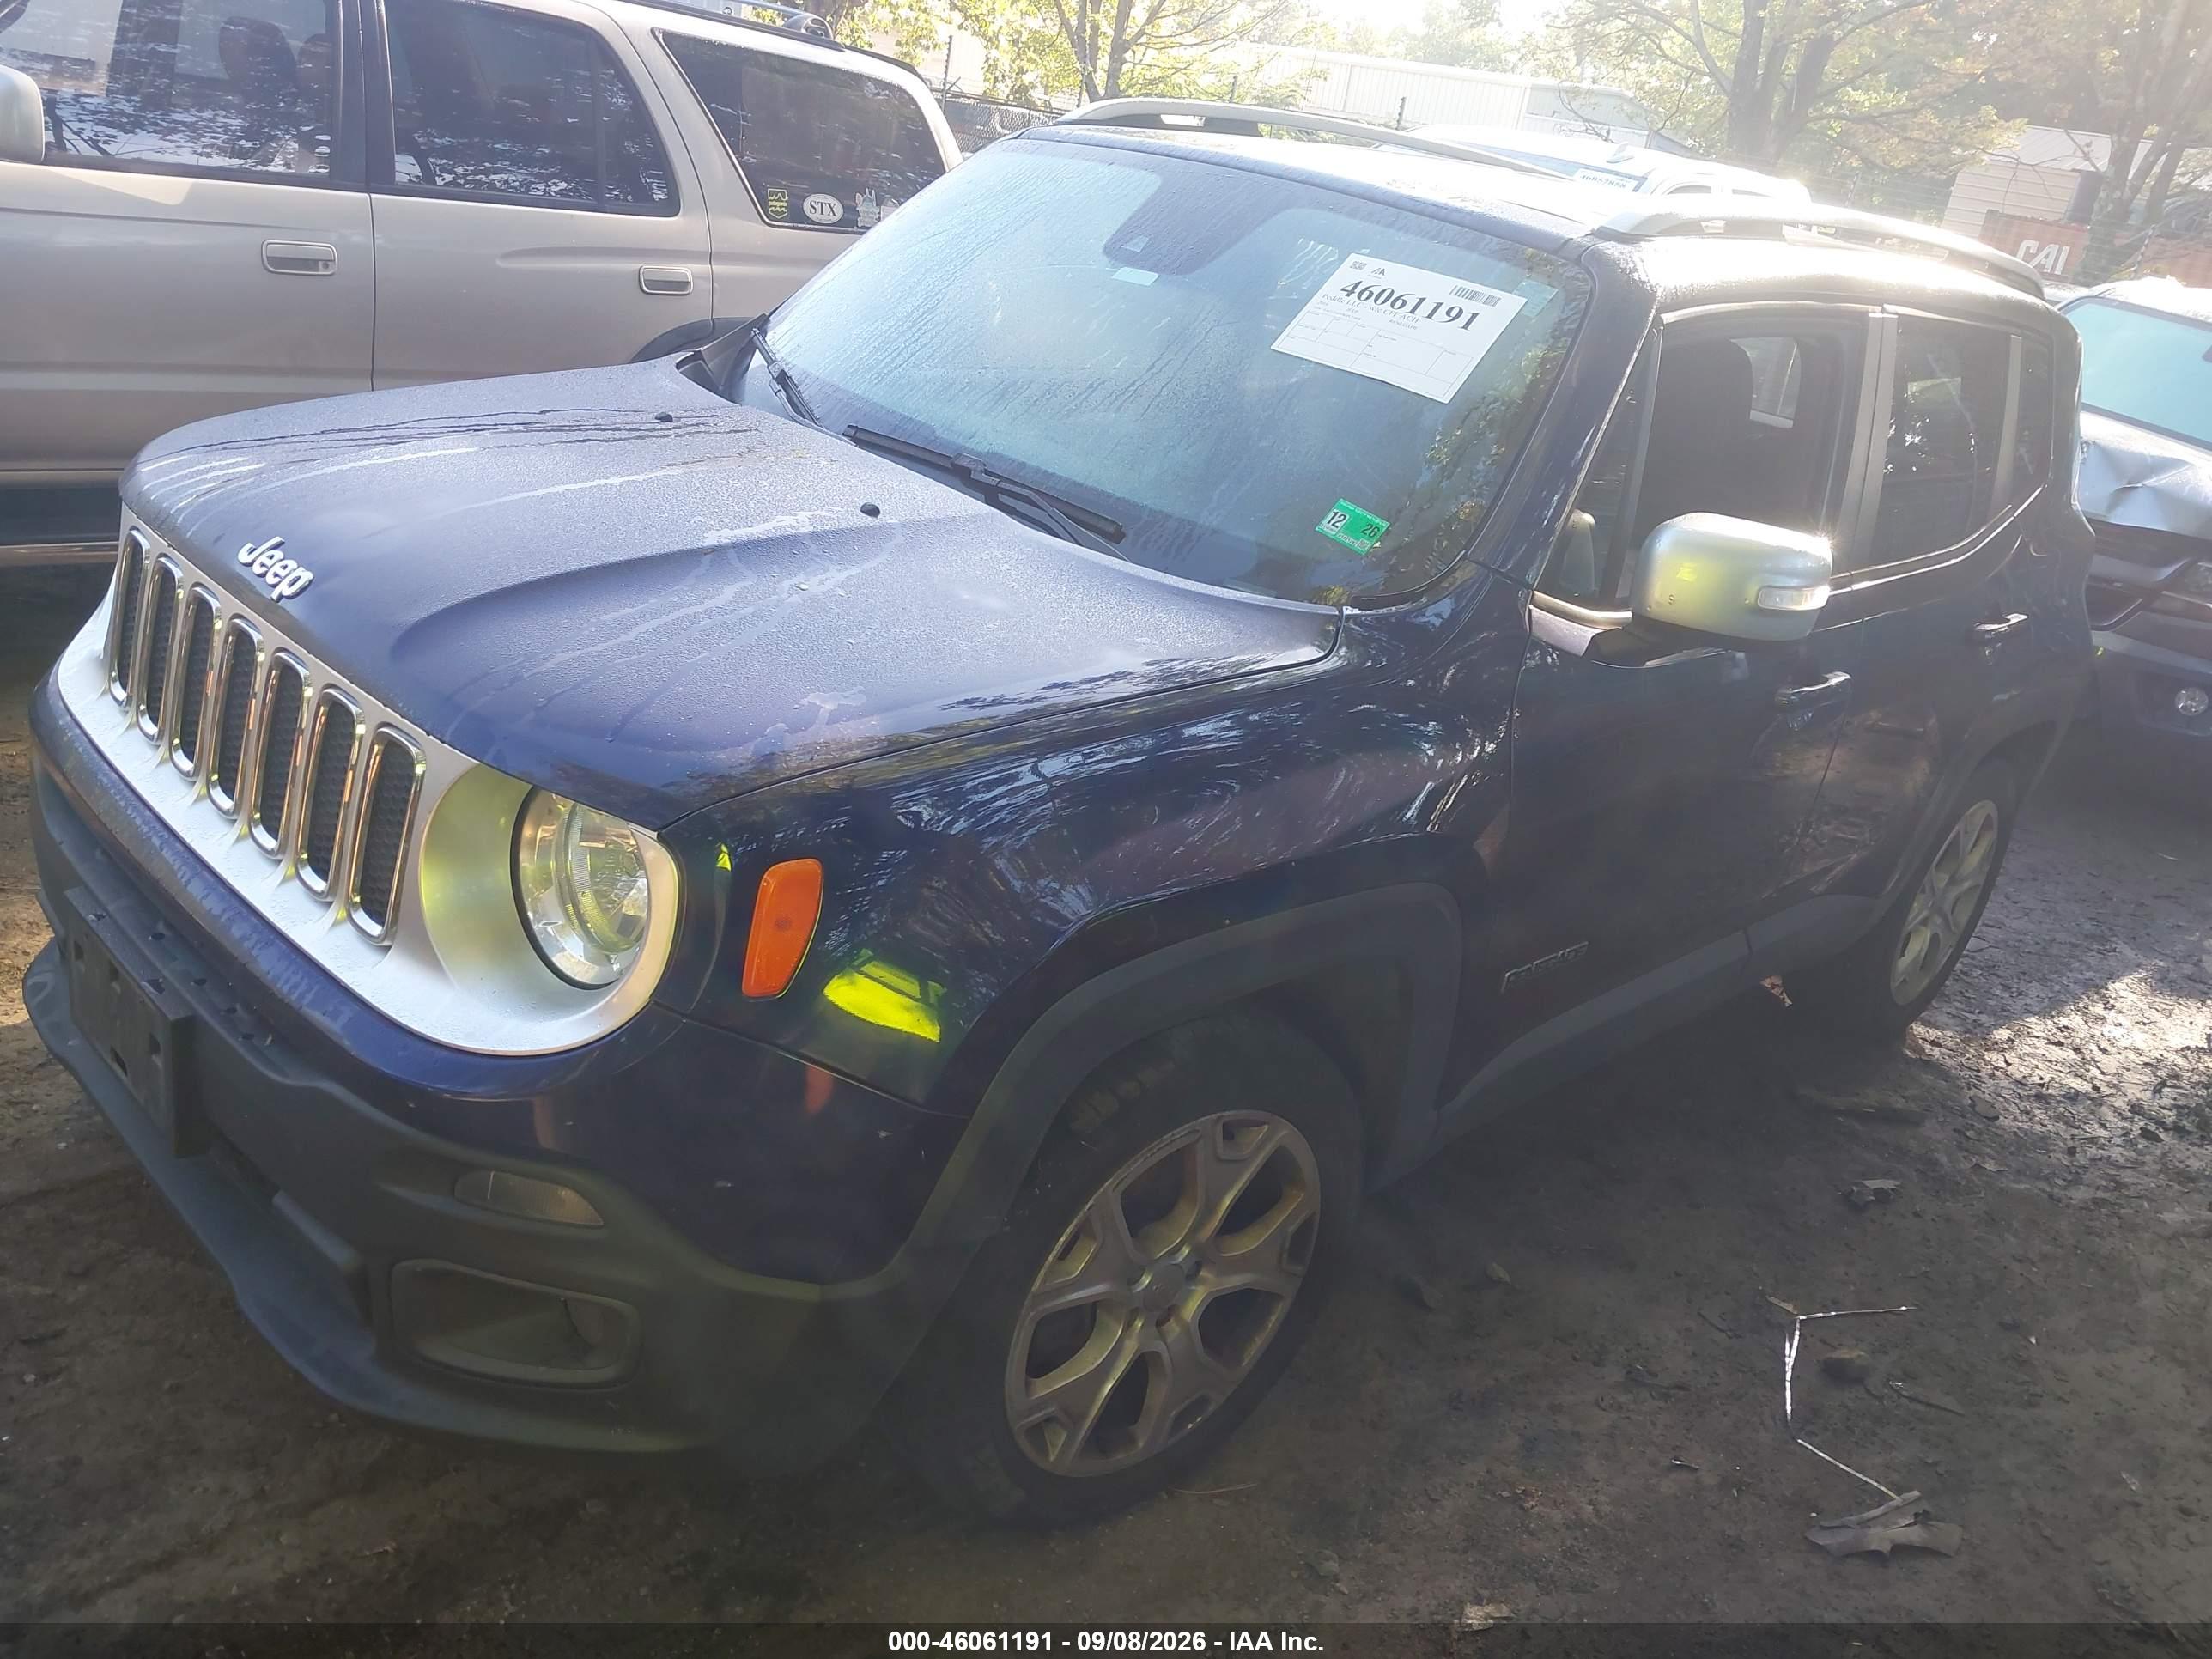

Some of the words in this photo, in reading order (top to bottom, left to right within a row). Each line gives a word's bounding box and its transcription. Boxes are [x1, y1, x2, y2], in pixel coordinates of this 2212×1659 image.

[809, 200, 837, 216] STX
[1340, 279, 1480, 331] 46061191
[1346, 300, 1361, 308] LLC
[1327, 511, 1346, 529] 12
[1361, 523, 1380, 538] 26
[238, 536, 314, 603] Jeep
